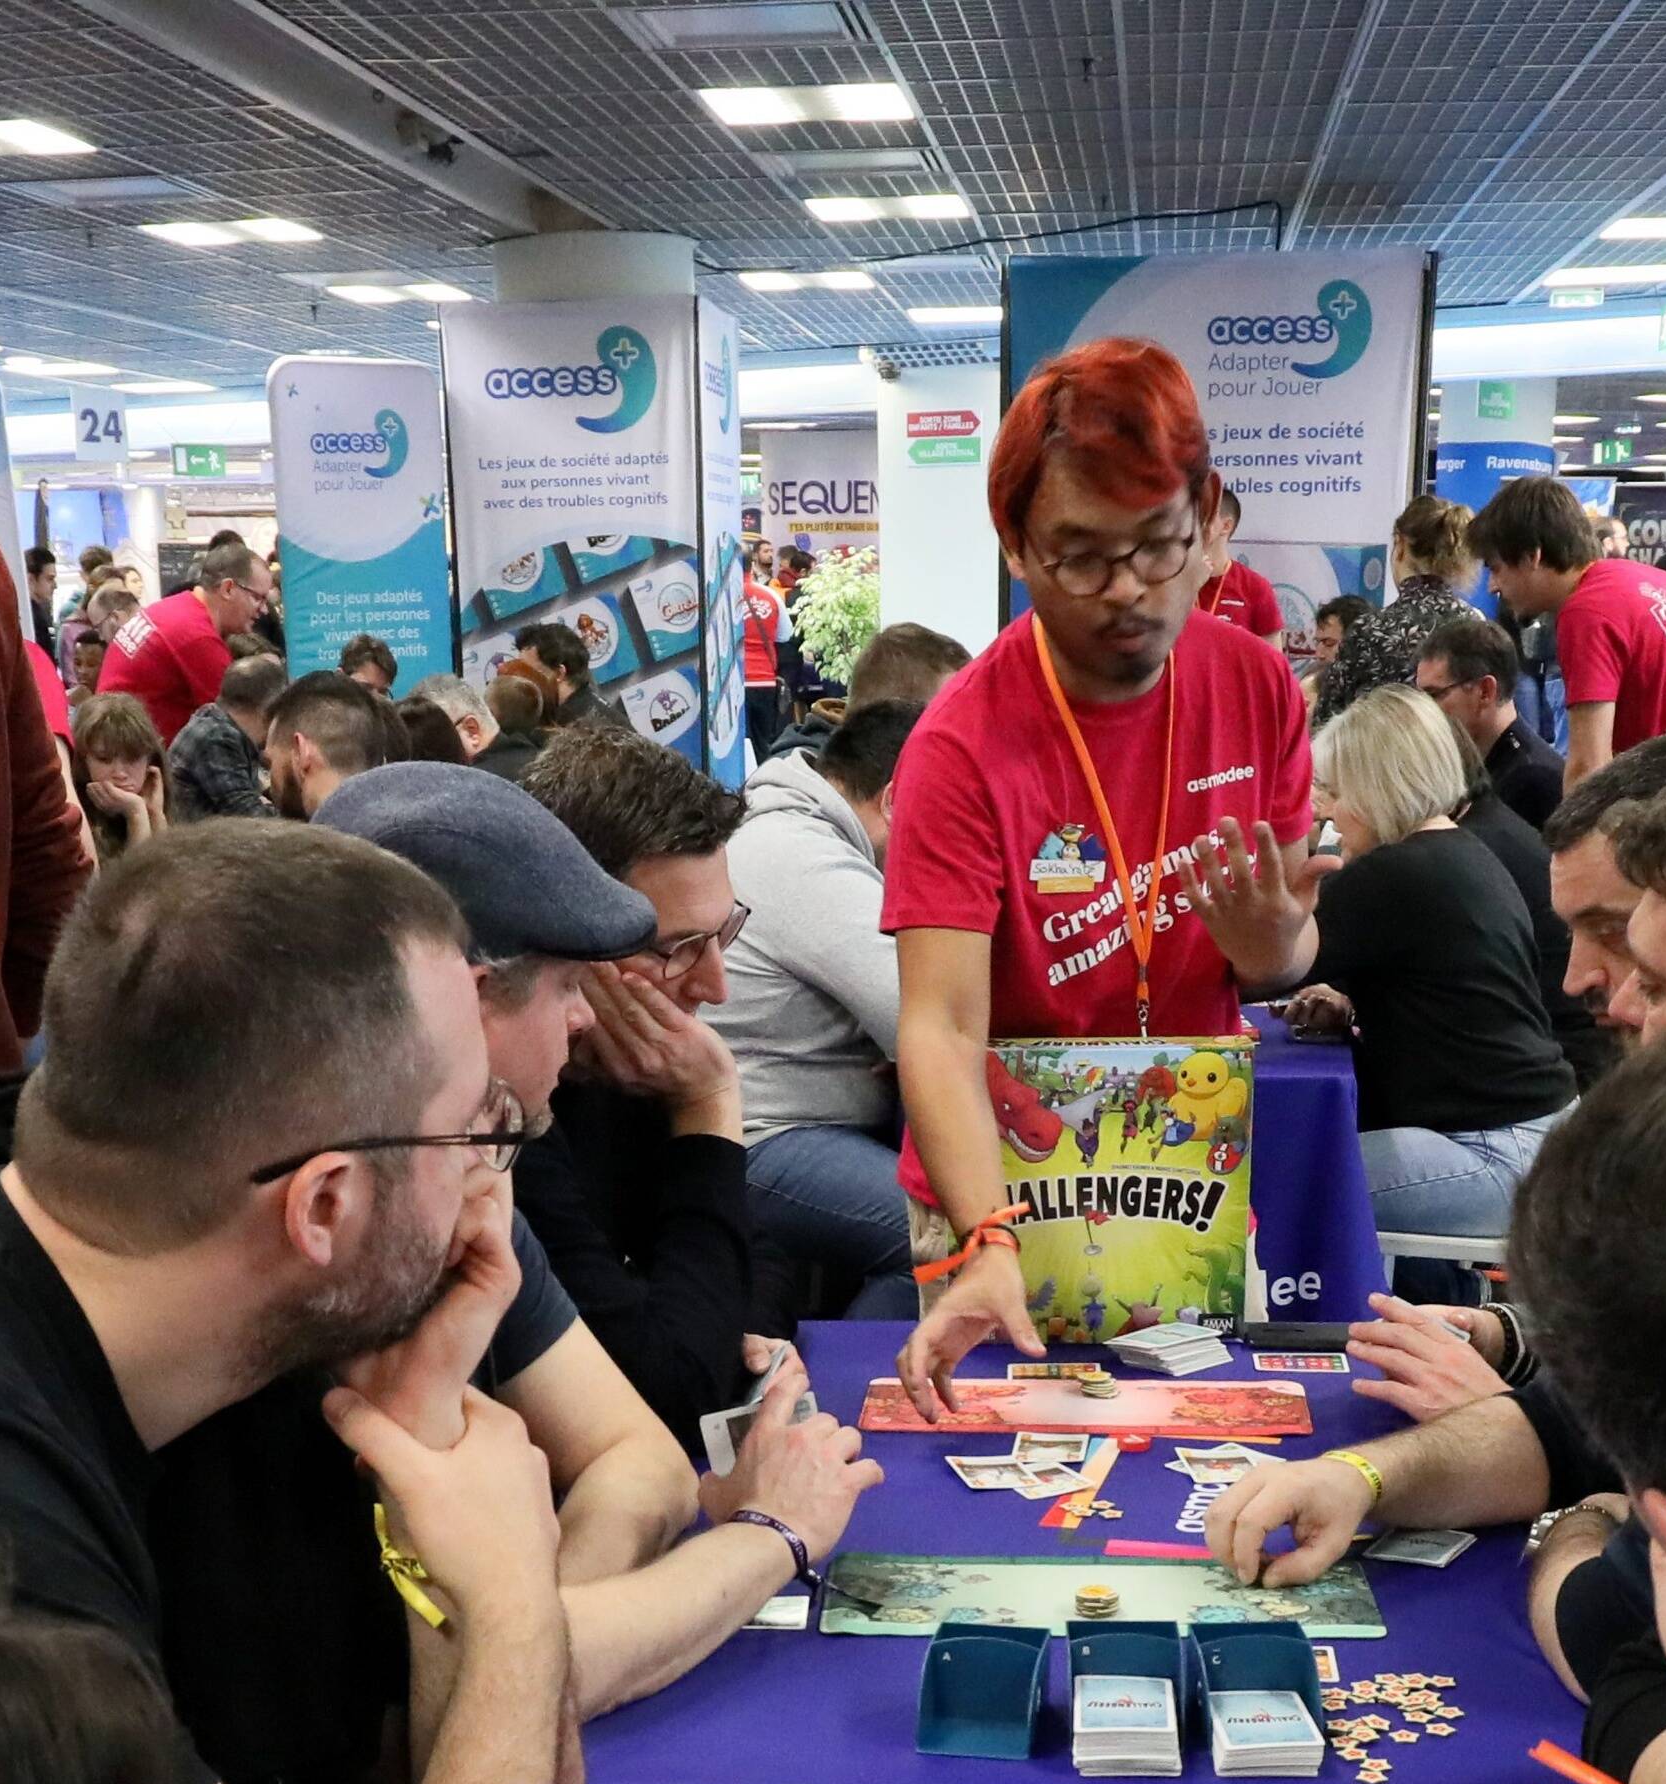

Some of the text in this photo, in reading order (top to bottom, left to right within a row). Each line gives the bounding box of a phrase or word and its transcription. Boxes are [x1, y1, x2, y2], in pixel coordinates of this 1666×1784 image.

[1208, 352, 1290, 375] Adapter
[1208, 377, 1323, 400] pour Jouer
[80, 408, 123, 444] 24
[1221, 424, 1262, 443] jeux
[1269, 423, 1291, 439] de
[1297, 420, 1364, 438] société
[312, 459, 363, 475] Adapter
[478, 450, 669, 473] Les jeux de société adaptés
[1305, 449, 1363, 466] vivant
[314, 476, 385, 494] pour Jouer
[501, 473, 650, 491] aux personnes vivant
[1279, 475, 1361, 496] cognitifs
[483, 491, 669, 510] avec des troubles cognitifs
[317, 588, 423, 608] Des jeux adaptés
[310, 609, 430, 627] pour les personnes
[398, 625, 420, 639] des
[1186, 764, 1255, 794] asmodee
